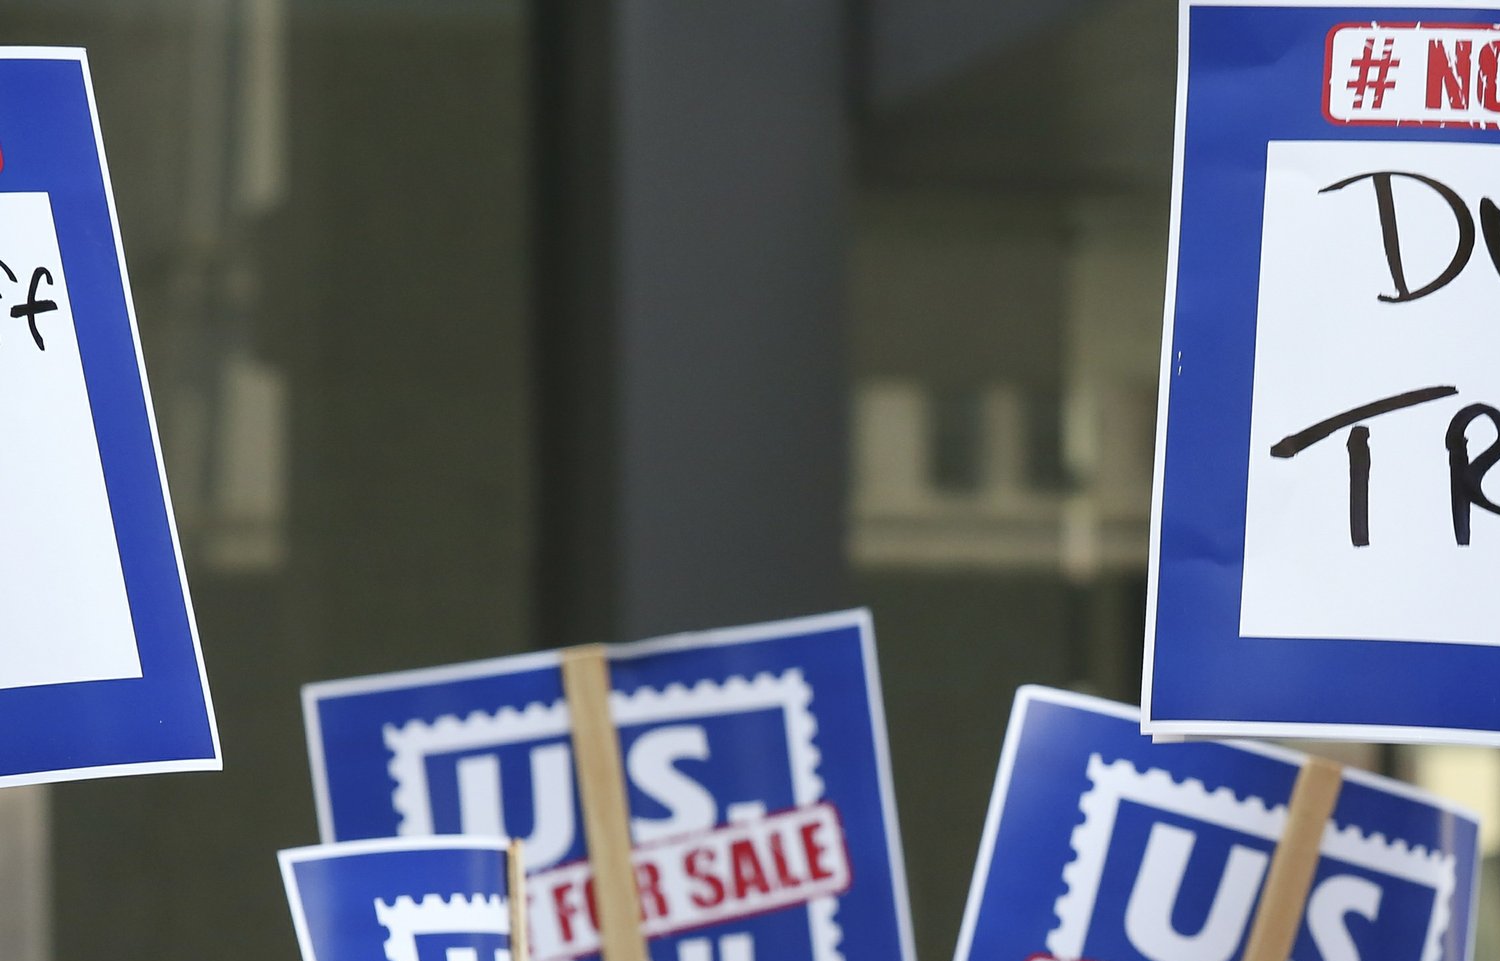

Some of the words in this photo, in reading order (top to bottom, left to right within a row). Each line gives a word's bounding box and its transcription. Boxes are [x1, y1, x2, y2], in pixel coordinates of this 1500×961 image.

[1346, 37, 1400, 111] #
[455, 724, 766, 872] US.
[684, 822, 833, 908] SALE
